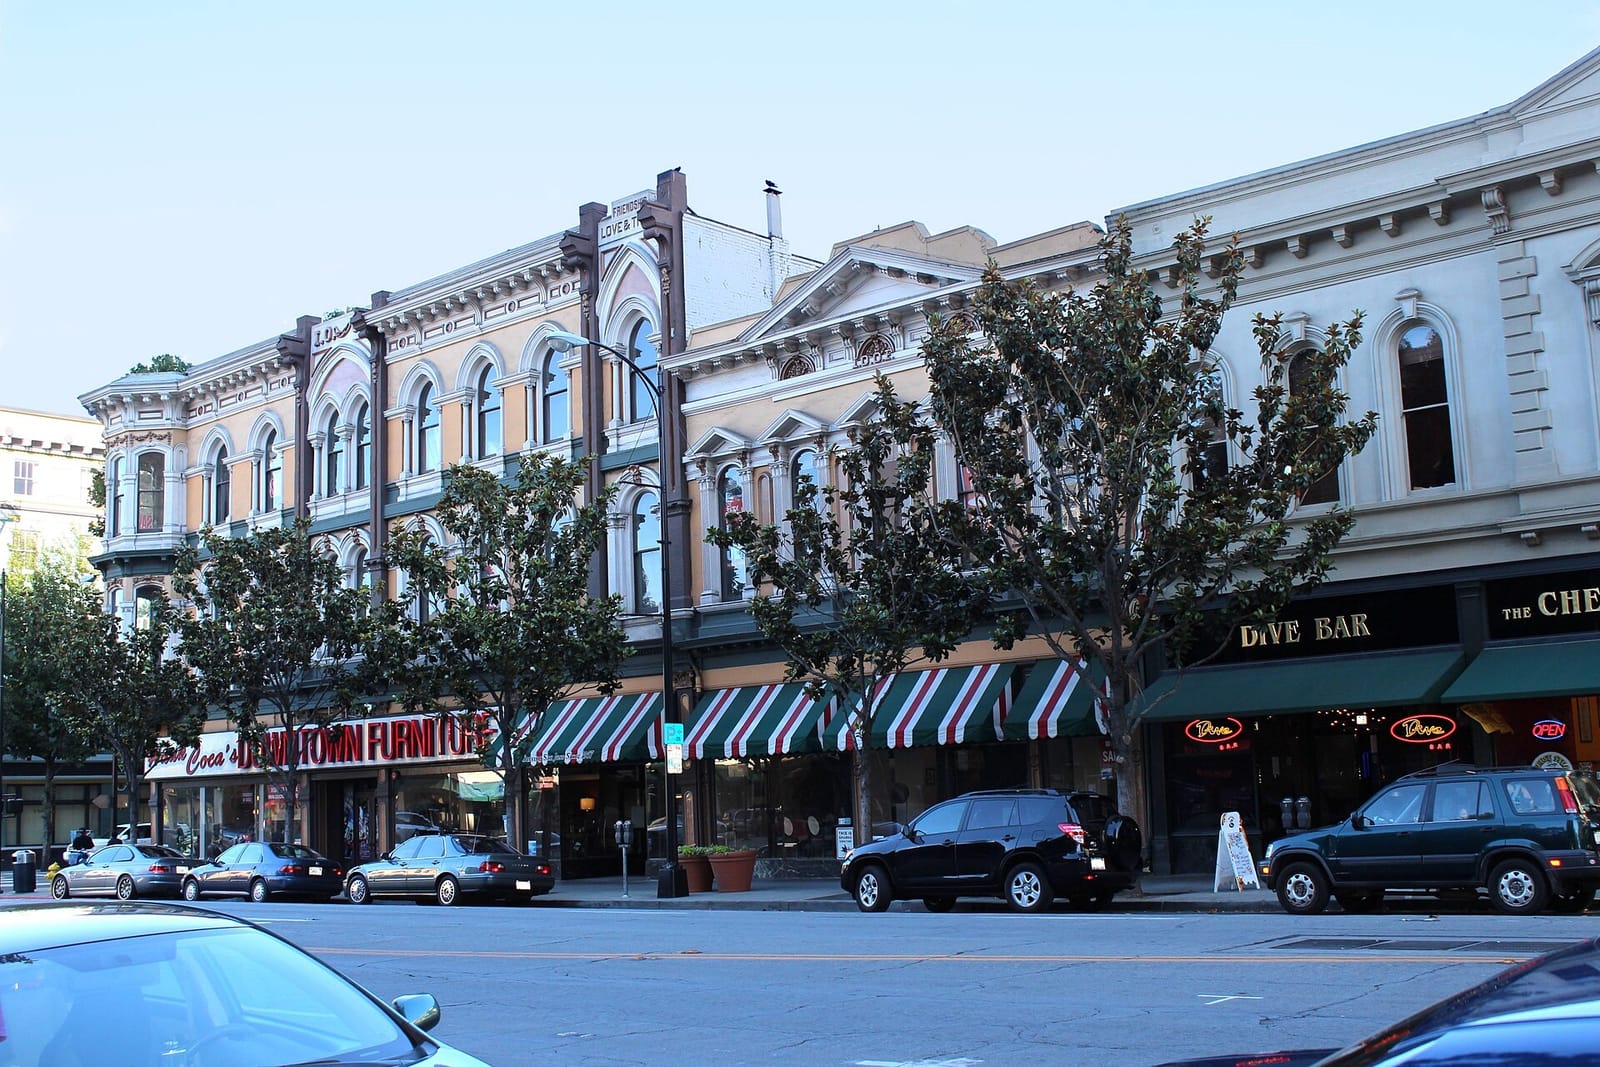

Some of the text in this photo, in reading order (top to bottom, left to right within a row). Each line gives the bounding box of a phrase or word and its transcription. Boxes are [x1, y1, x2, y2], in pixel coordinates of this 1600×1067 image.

[612, 197, 647, 217] FRIENDSHI
[600, 221, 623, 239] LOVE
[623, 219, 631, 231] &
[1502, 587, 1600, 620] THE CHE
[1240, 613, 1371, 648] DIVE BAR
[1195, 720, 1233, 738] Dive
[1401, 718, 1445, 738] Dive
[1532, 723, 1566, 737] OPEN
[237, 724, 363, 769] DOWTOWN
[1429, 743, 1452, 751] BAR
